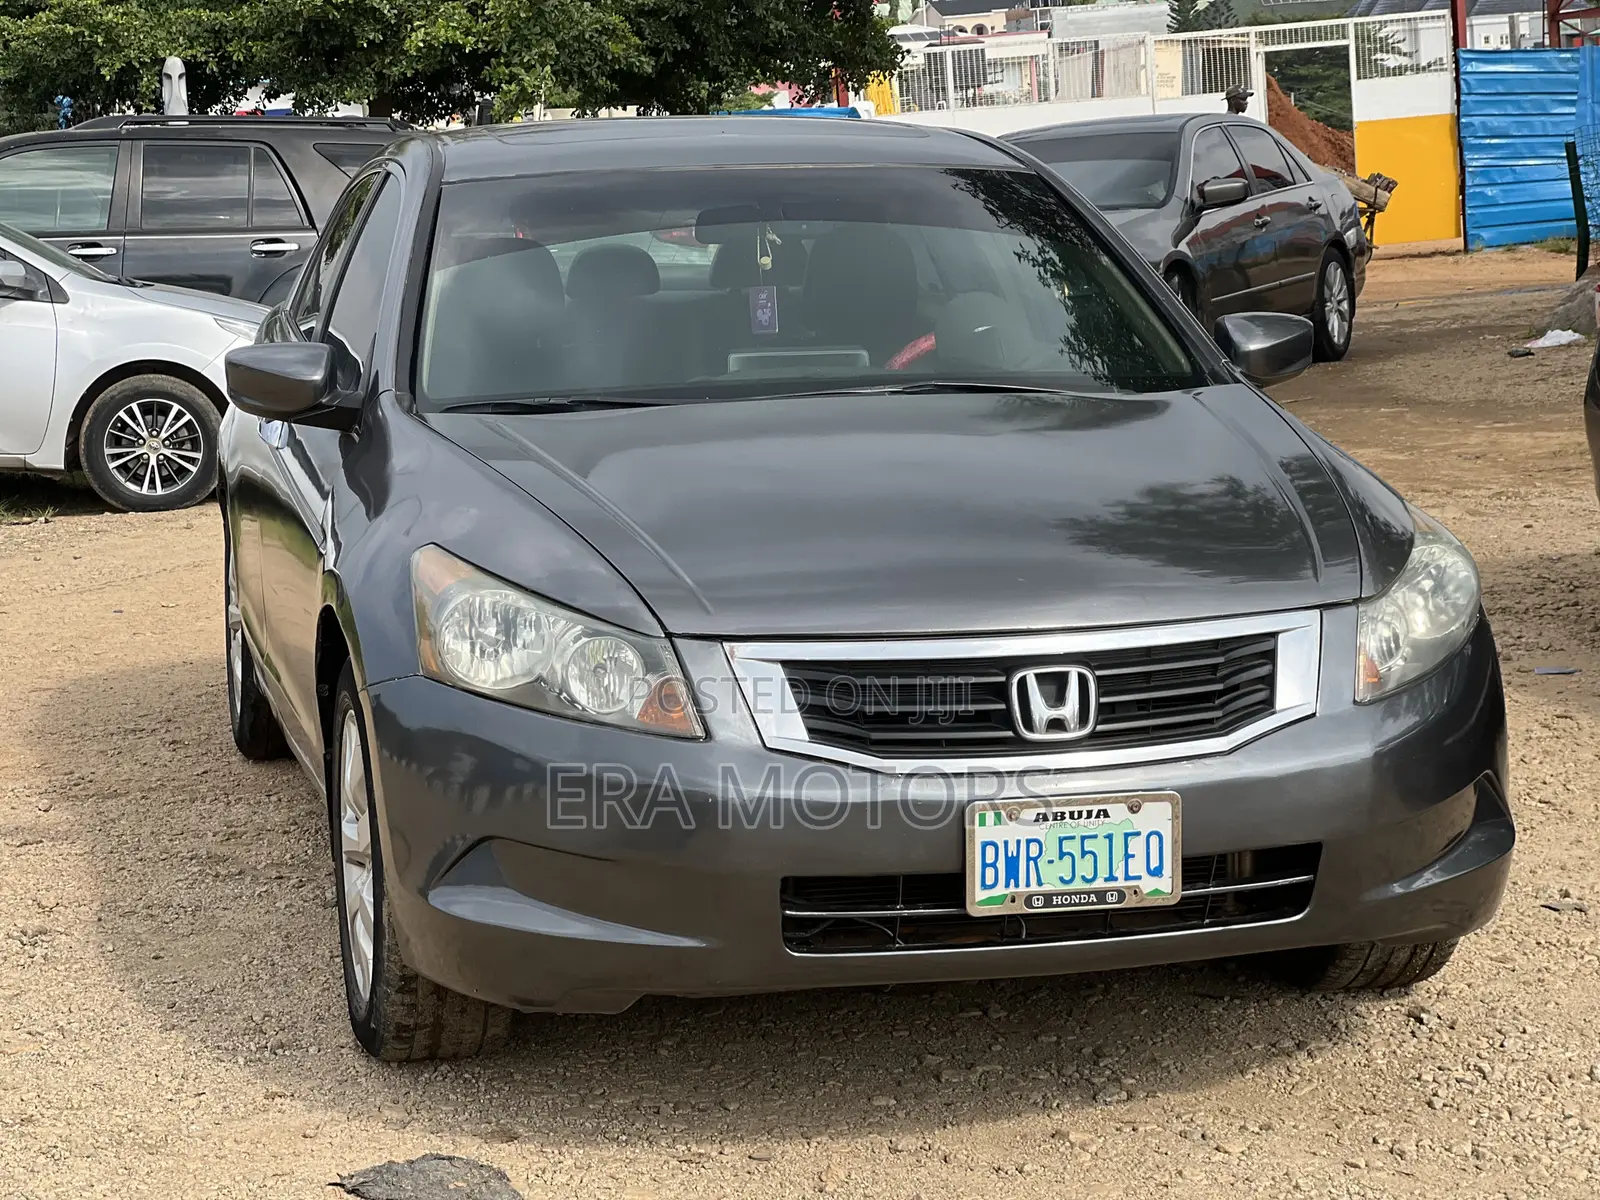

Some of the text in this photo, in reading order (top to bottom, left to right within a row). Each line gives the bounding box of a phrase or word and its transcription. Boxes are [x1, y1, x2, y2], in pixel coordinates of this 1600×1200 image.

[1033, 808, 1111, 823] ABUJA
[1039, 822, 1069, 831] CENTRE
[1083, 819, 1106, 828] UNITY
[980, 830, 1165, 890] BWR-551EQ
[1052, 893, 1098, 905] HONDA
